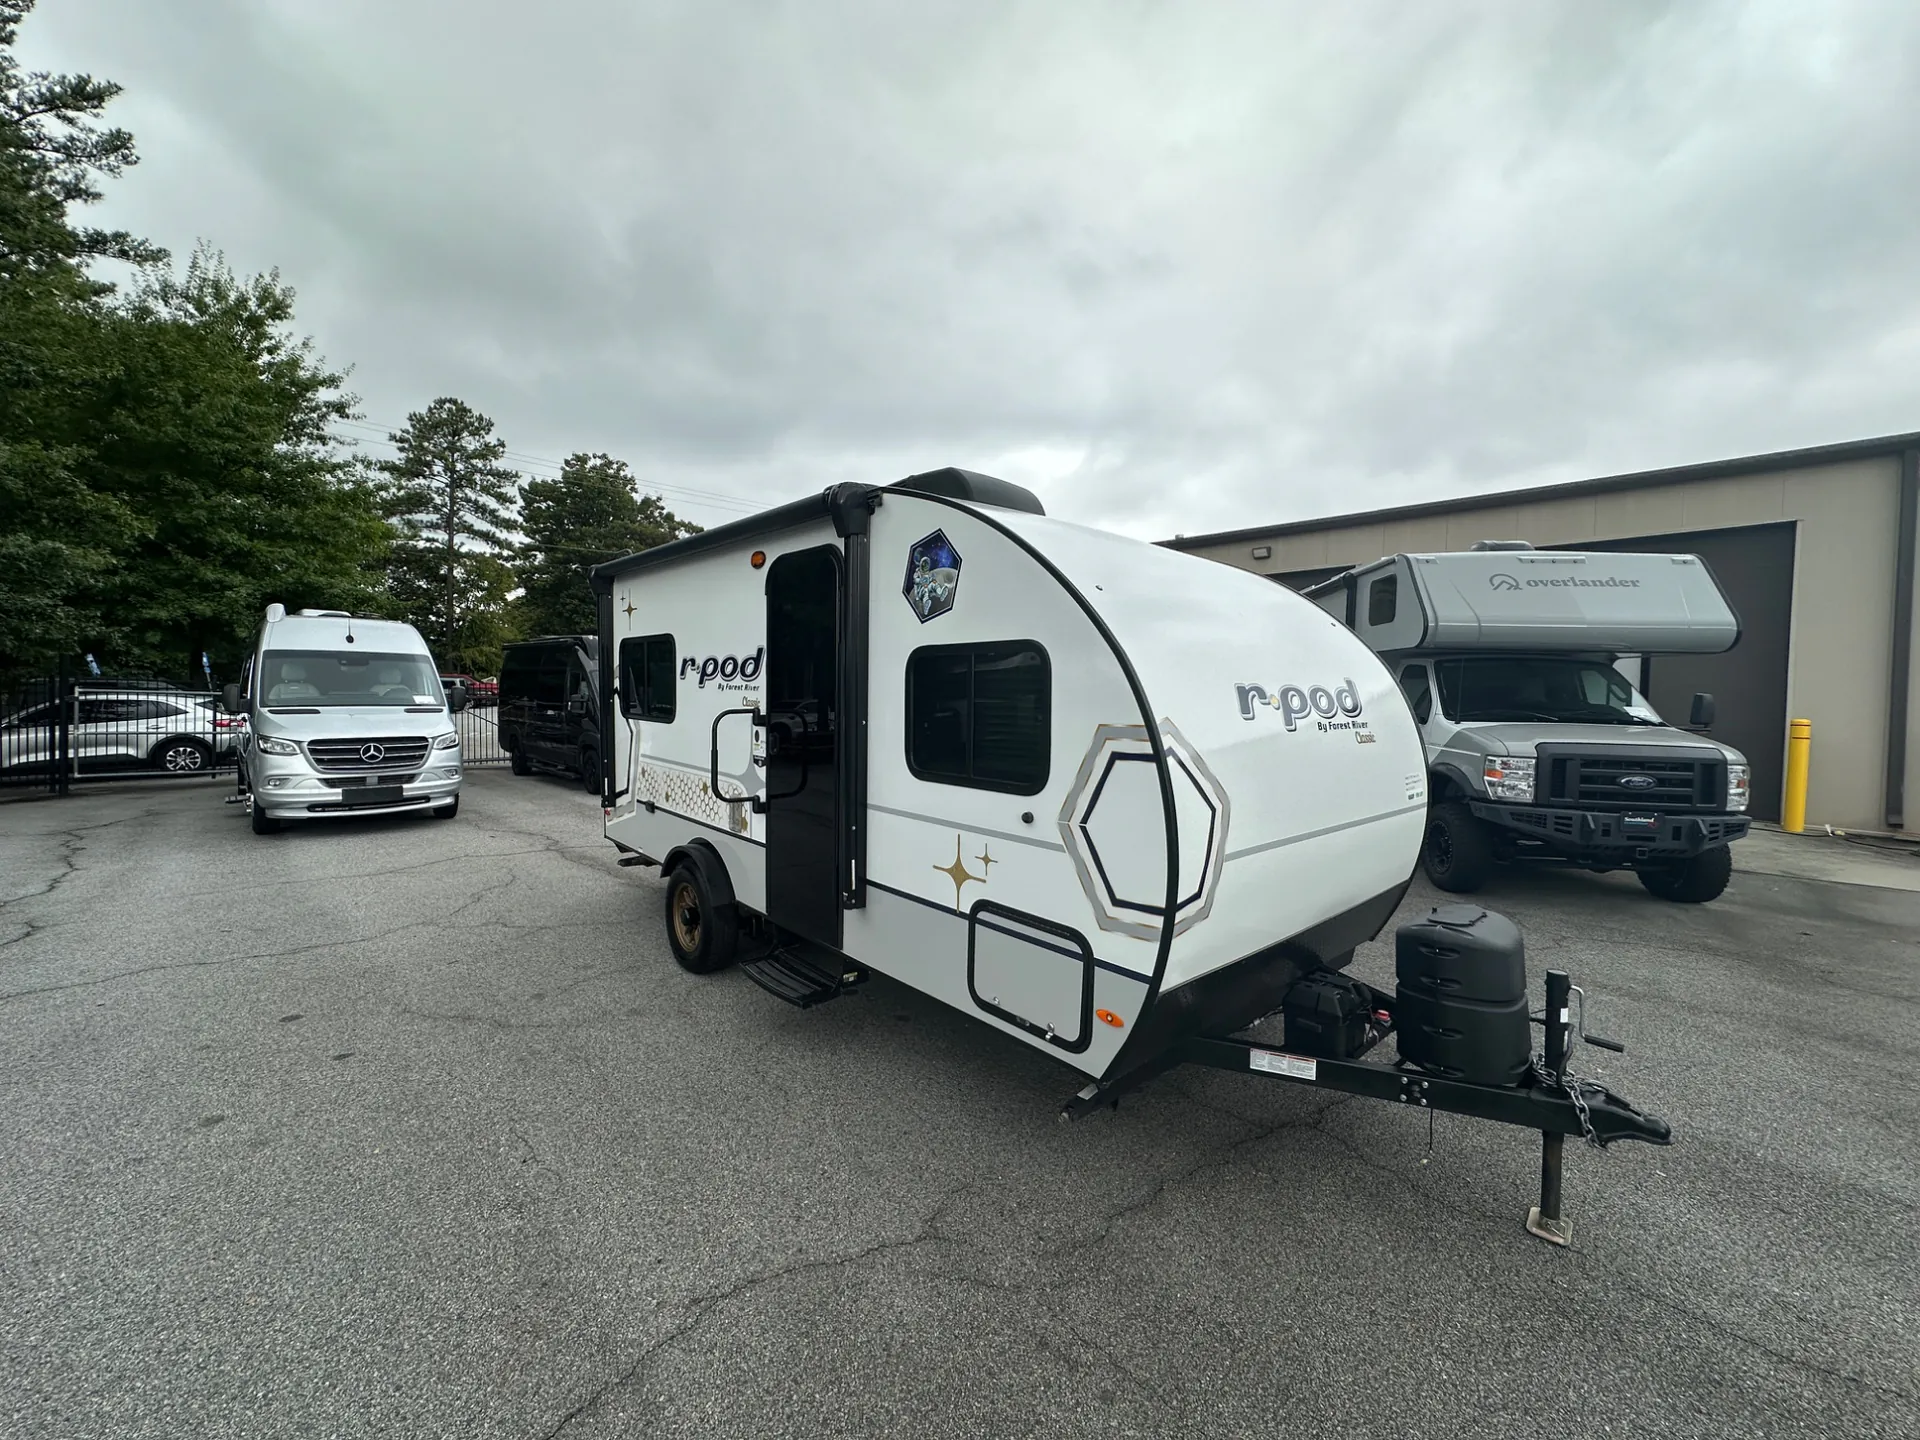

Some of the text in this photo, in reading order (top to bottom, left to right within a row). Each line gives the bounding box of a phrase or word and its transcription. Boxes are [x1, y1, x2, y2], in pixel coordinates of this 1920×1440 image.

[1525, 576, 1641, 588] overlander
[717, 683, 760, 692] By Forest River
[1317, 720, 1368, 732] By Forest River
